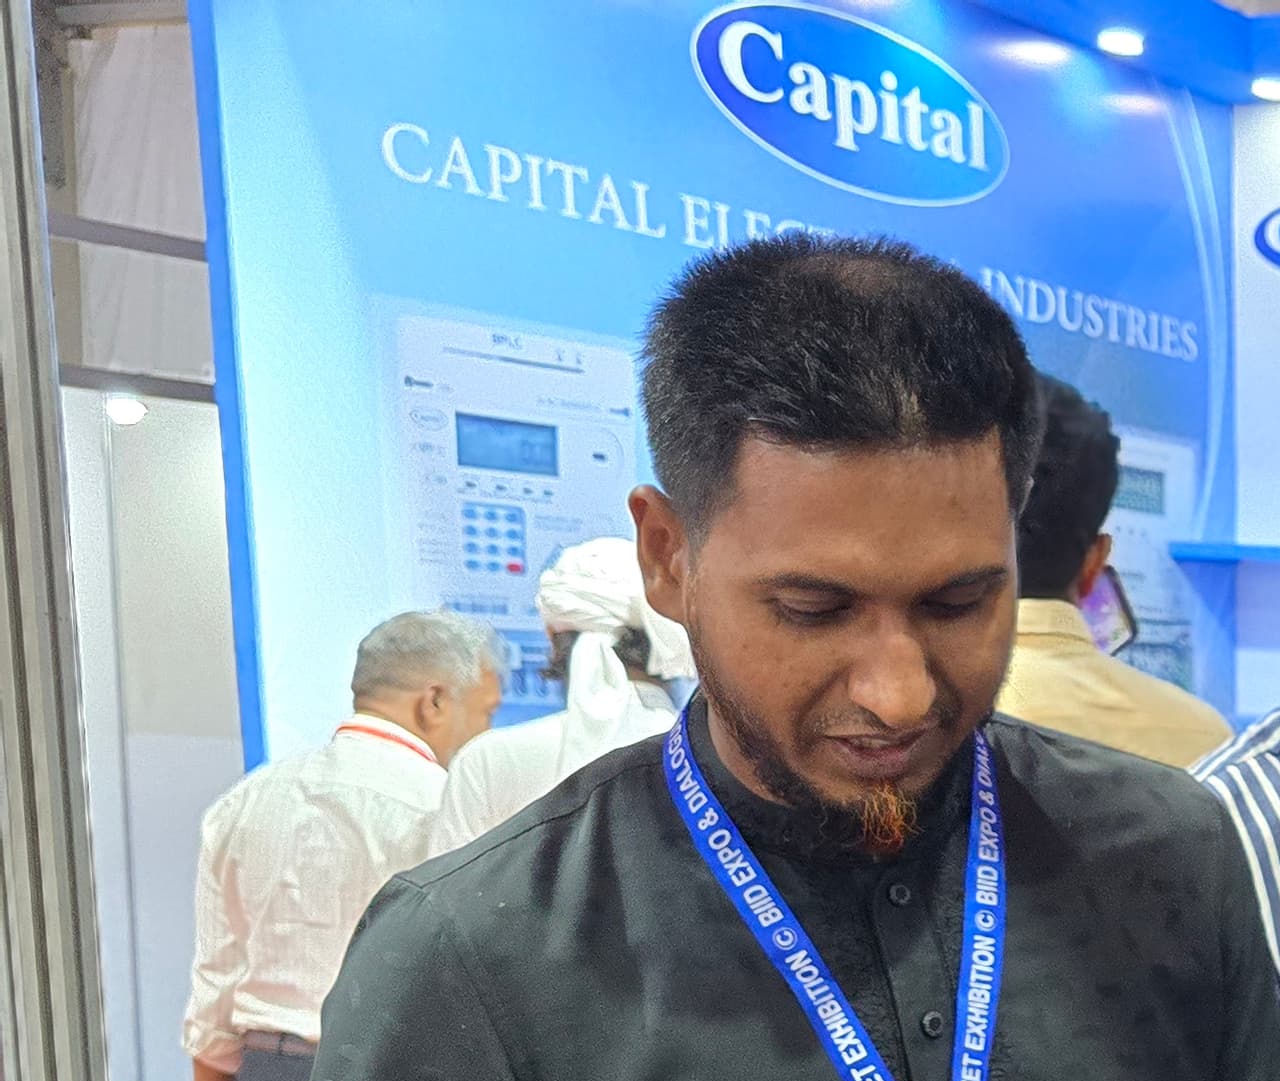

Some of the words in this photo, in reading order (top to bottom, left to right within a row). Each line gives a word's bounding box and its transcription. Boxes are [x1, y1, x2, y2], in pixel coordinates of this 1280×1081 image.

[716, 20, 988, 171] Capital
[379, 122, 667, 240] CAPITAL
[697, 807, 720, 831] &
[978, 789, 995, 806] &
[707, 828, 758, 888] EXPO
[978, 806, 1000, 861] EXPO
[743, 884, 785, 928] BIID
[975, 865, 999, 907] BIID
[784, 949, 869, 1066] EXHIBITION
[964, 934, 997, 1052] EXHIBITION
